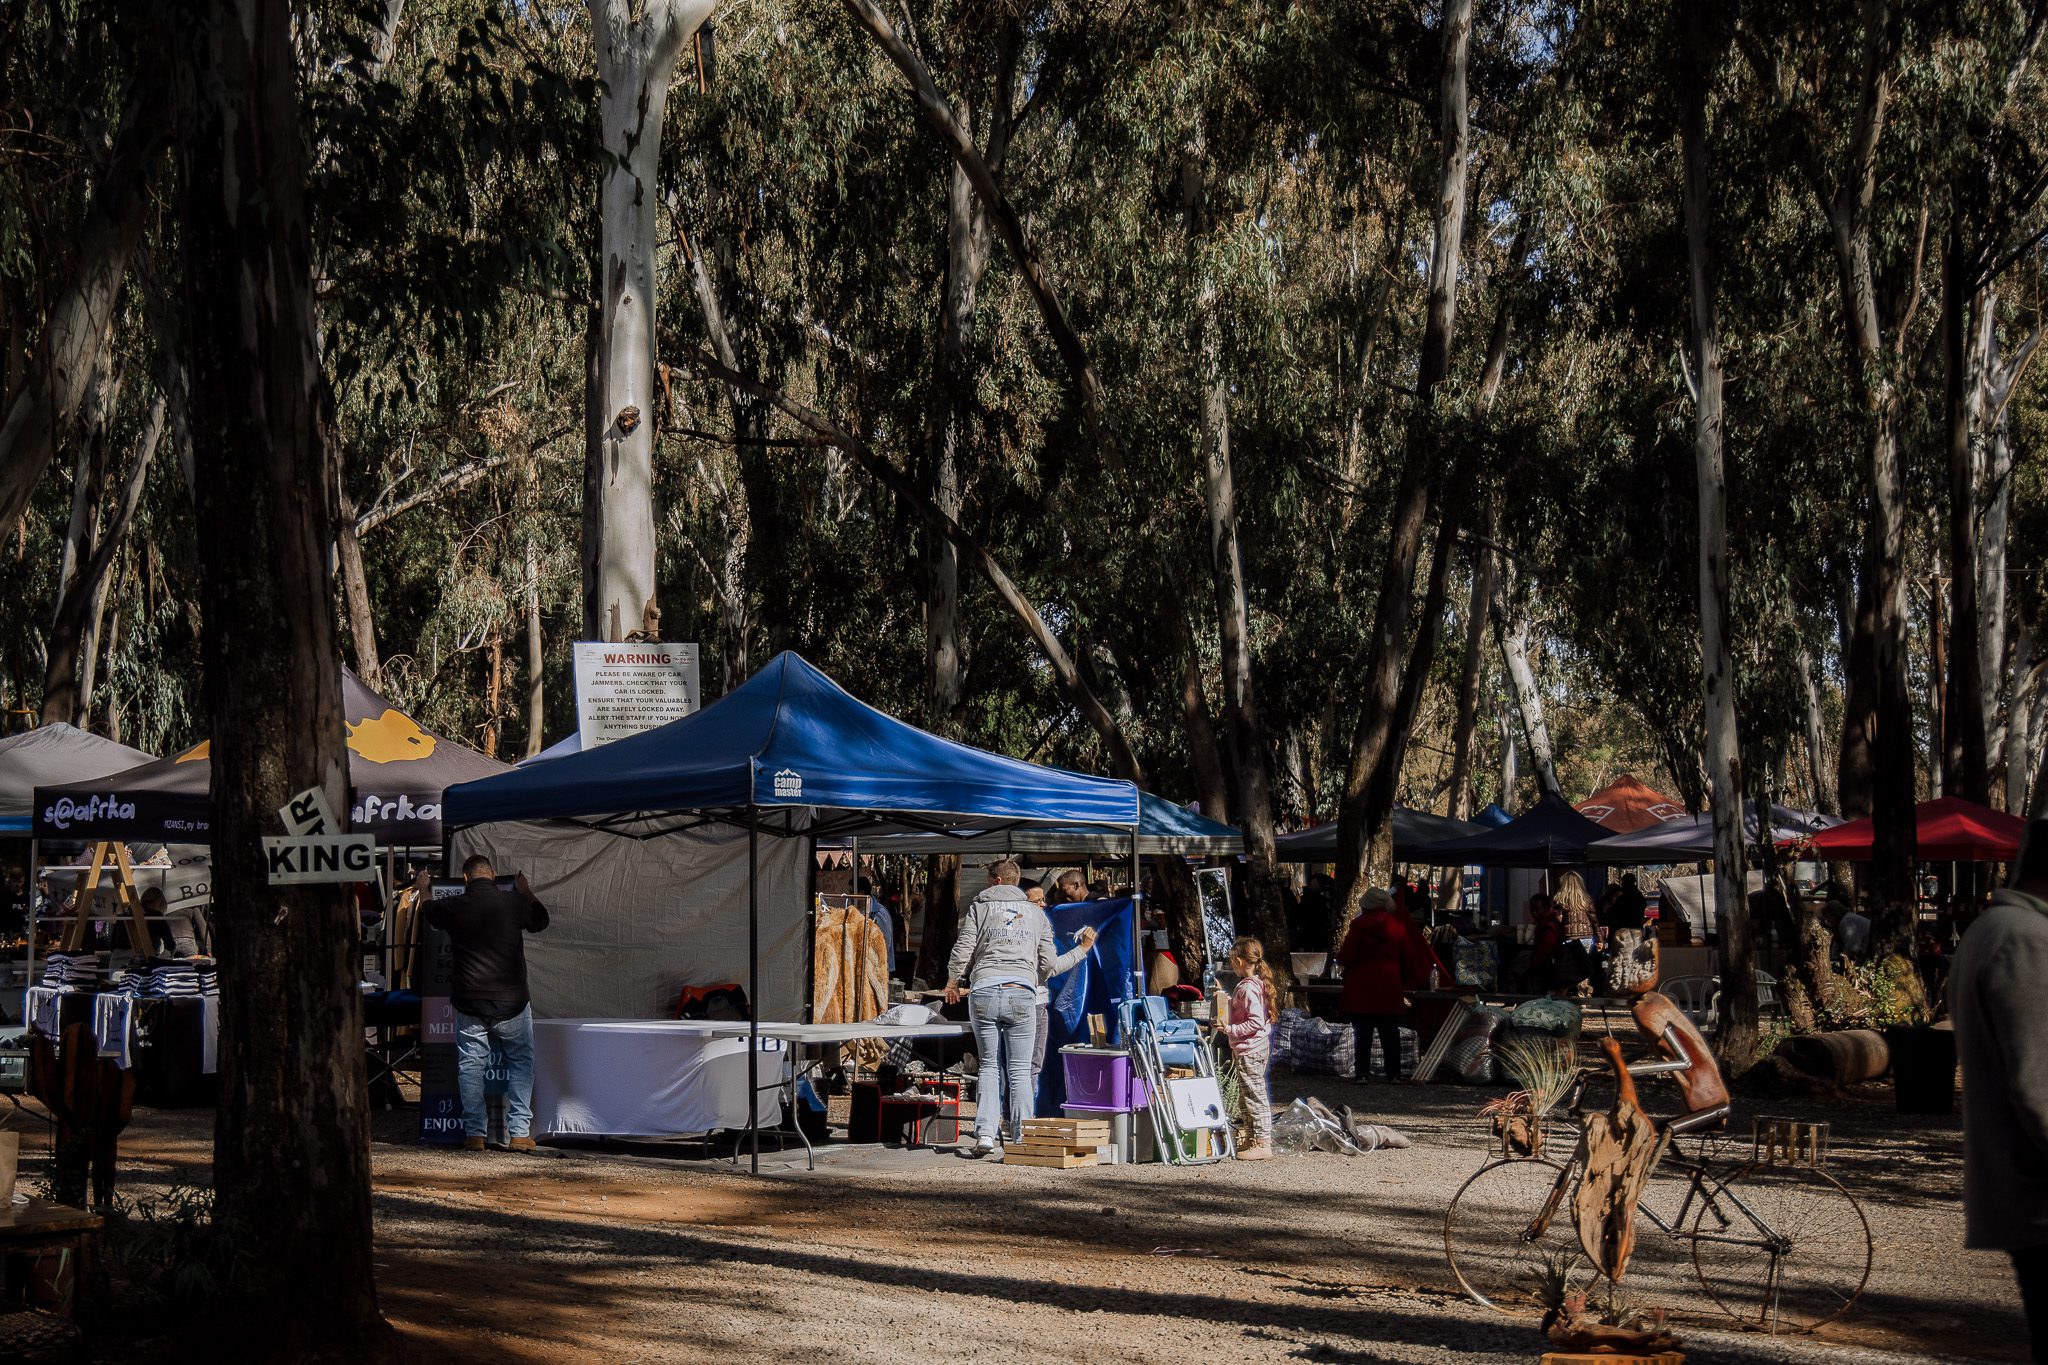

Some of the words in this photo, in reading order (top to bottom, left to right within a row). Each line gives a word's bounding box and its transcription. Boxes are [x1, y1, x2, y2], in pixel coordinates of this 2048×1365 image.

[604, 654, 671, 664] WARNING
[773, 777, 802, 789] camp
[774, 788, 802, 797] master
[43, 794, 136, 829] s@afrka
[269, 843, 370, 873] KING
[438, 1098, 453, 1113] 03
[424, 1117, 466, 1132] ENJOY
